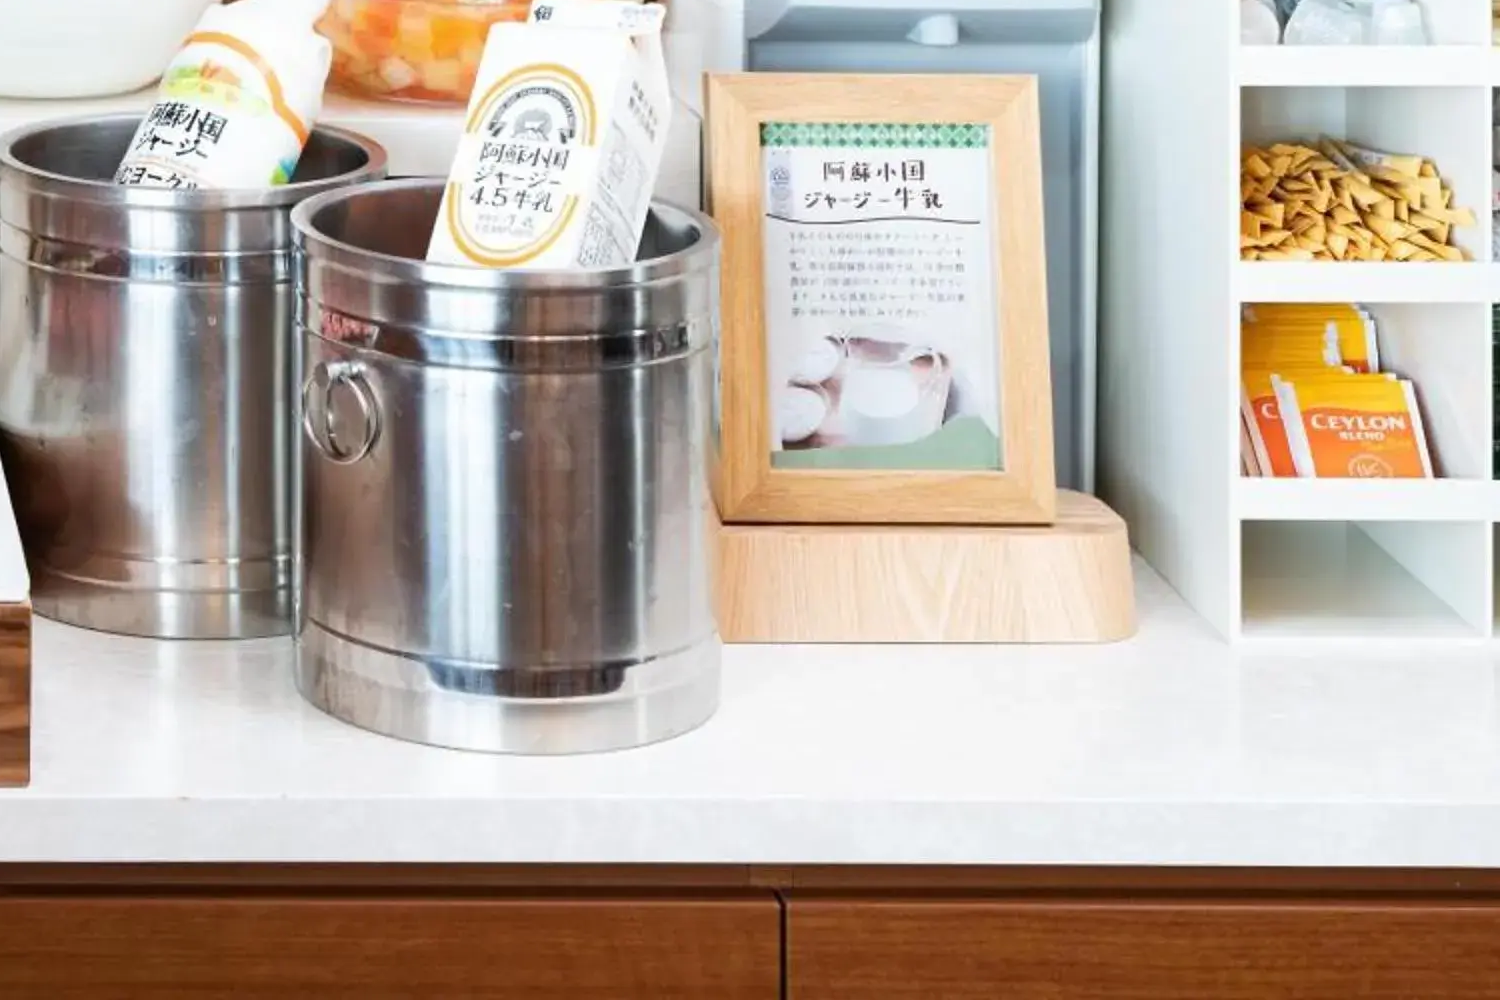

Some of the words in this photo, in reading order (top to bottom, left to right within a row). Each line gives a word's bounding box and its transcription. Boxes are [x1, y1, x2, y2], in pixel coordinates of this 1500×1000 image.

[474, 164, 562, 189] ジャージー
[823, 160, 925, 183] 阿蘇小国
[804, 186, 944, 211] ジャージー牛乳
[1310, 413, 1407, 432] CEYLON
[1338, 431, 1386, 442] BLEND
